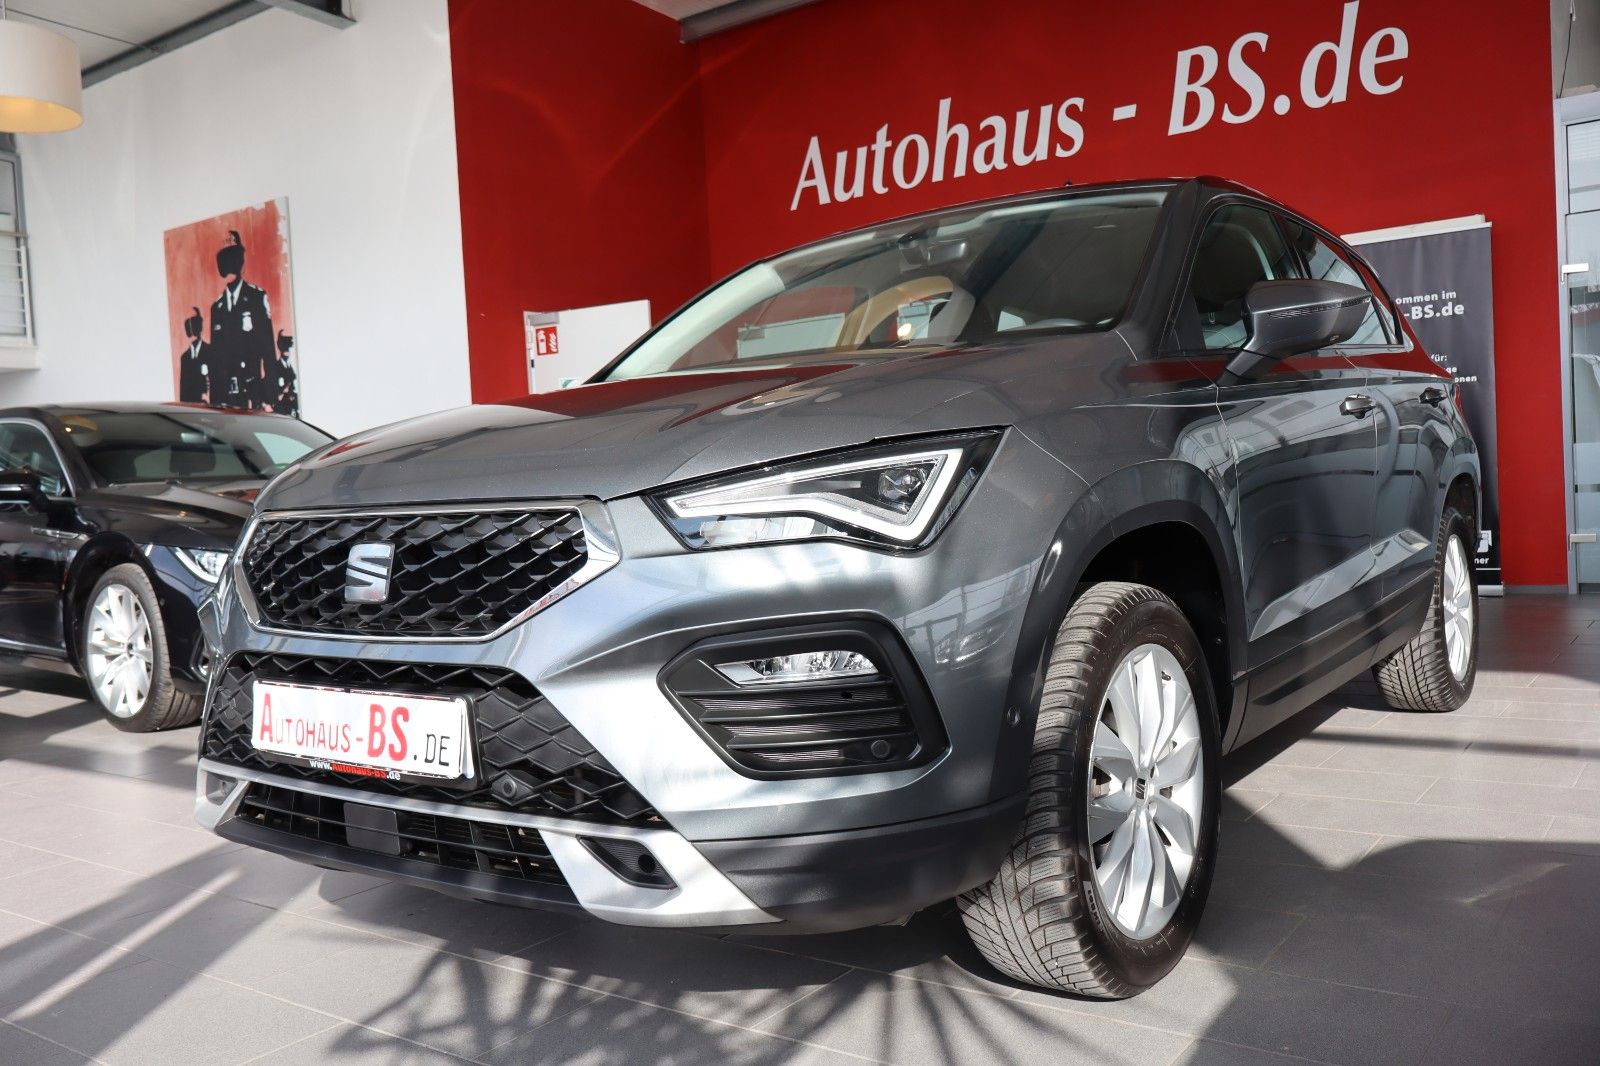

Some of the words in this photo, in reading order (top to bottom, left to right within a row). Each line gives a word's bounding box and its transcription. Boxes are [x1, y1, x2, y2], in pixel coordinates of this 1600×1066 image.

[790, 97, 1085, 212] Autohaus
[1167, 1, 1410, 136] BS.de
[1395, 293, 1438, 305] ommen
[1441, 290, 1457, 300] im
[1403, 301, 1465, 320] -BS.de
[1446, 366, 1457, 374] ge
[1454, 375, 1478, 383] onen
[1474, 557, 1490, 565] ner
